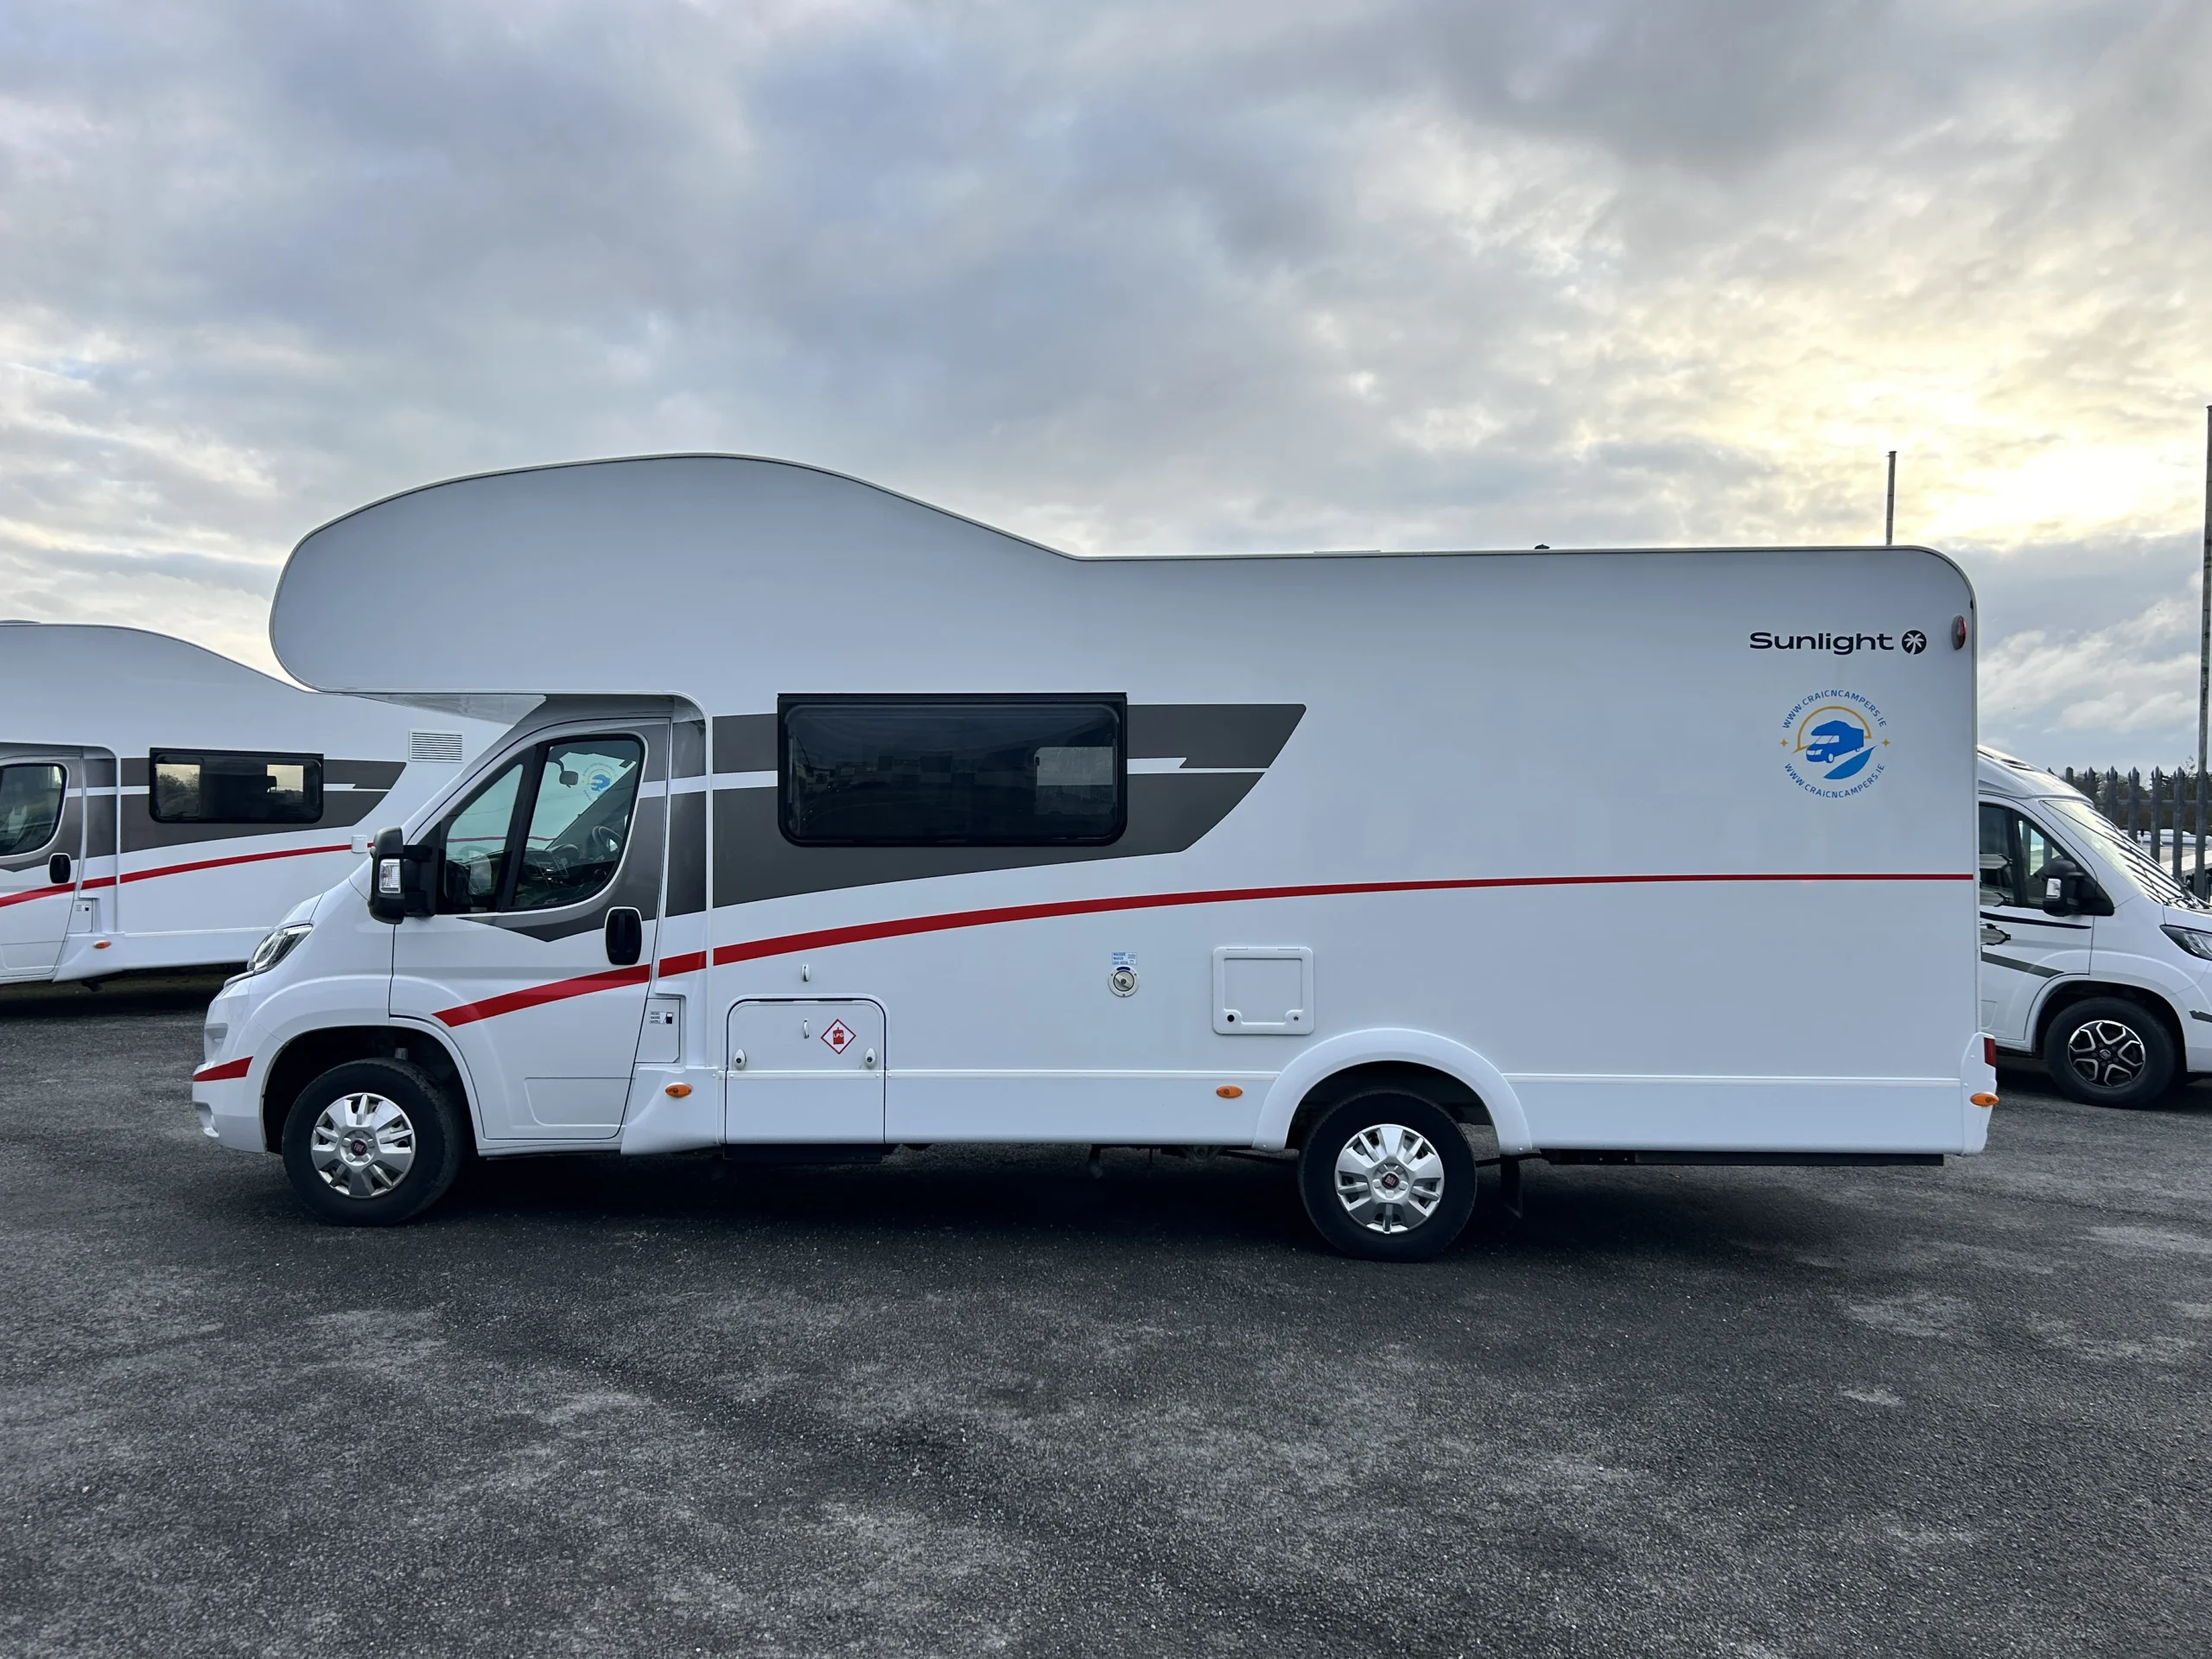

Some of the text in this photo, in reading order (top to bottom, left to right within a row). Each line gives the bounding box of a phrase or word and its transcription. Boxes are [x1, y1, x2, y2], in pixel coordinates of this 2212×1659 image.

[1750, 632, 1894, 655] Sunlight
[1783, 690, 1887, 728] WWW.CRAICNCAMPERS.IE
[1784, 763, 1885, 798] WWW.CRAICNCAMPERS.IE
